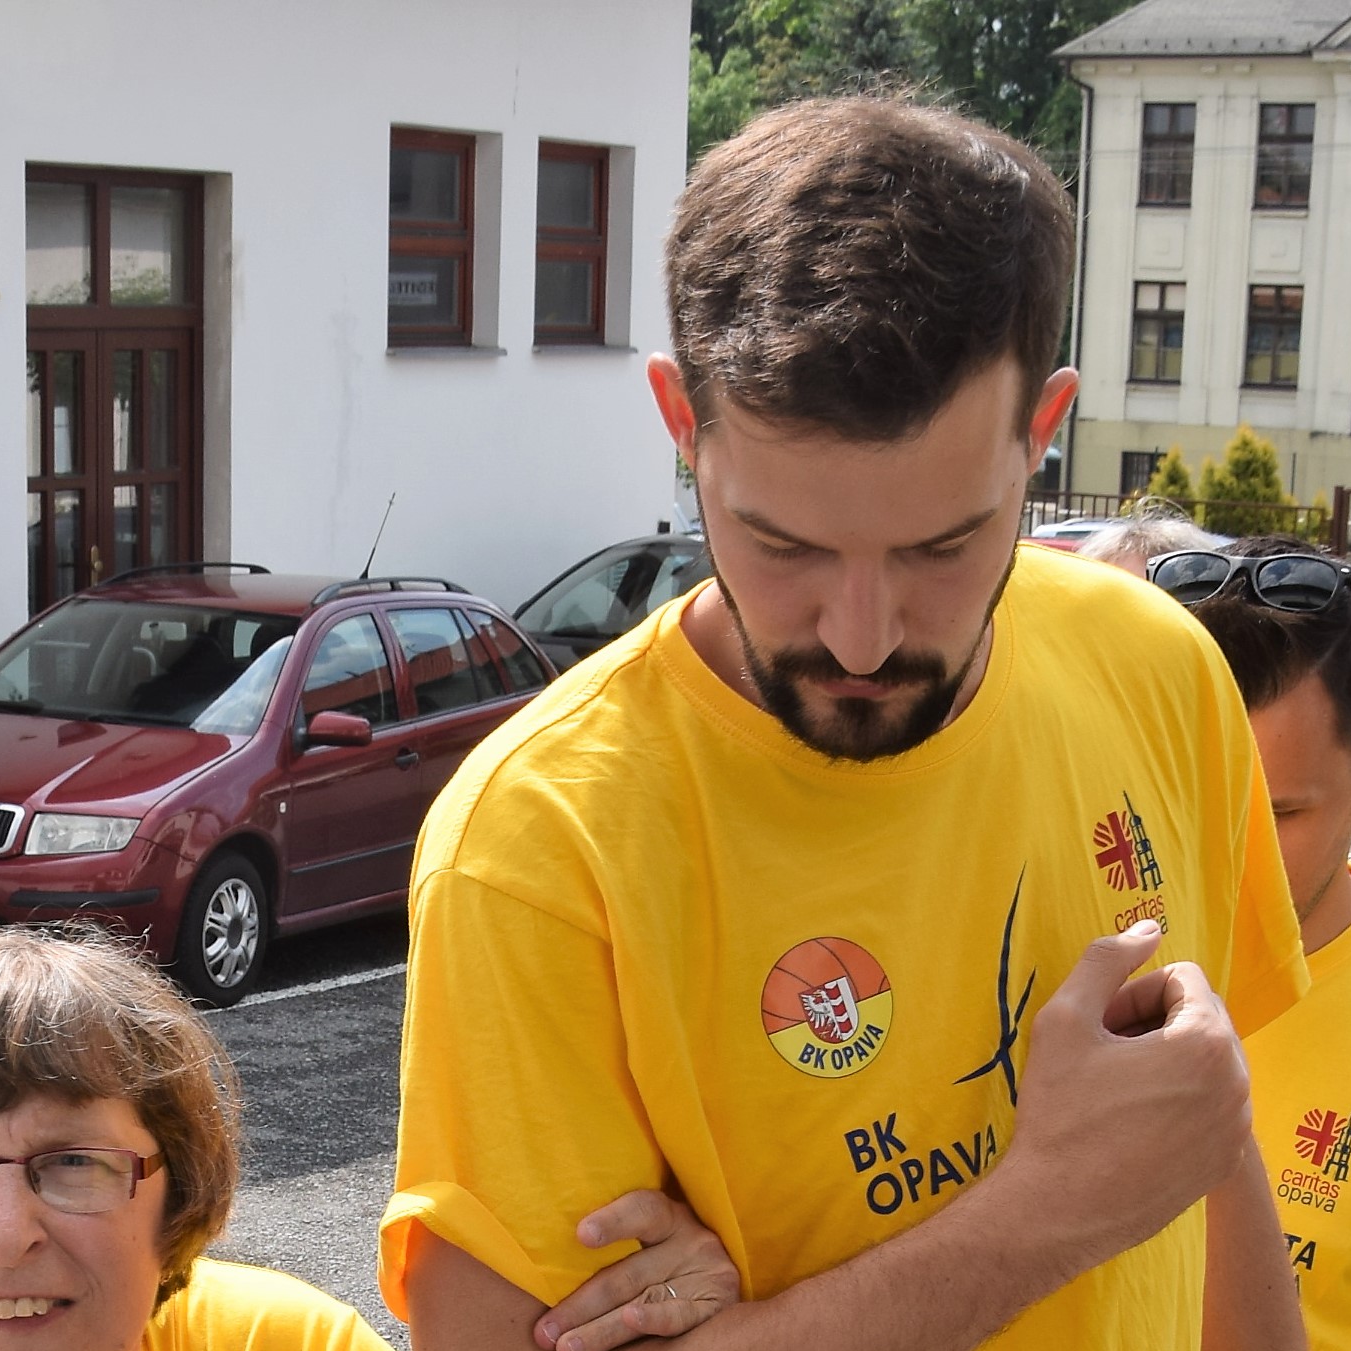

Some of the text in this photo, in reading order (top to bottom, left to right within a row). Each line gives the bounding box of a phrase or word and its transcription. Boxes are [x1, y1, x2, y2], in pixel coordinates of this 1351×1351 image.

[1114, 894, 1165, 934] caritas
[798, 1022, 885, 1071] BK OPAVA
[843, 1111, 907, 1173] BK
[866, 1123, 997, 1216] OPAVA
[1281, 1168, 1341, 1199] caritas
[1277, 1183, 1336, 1214] opava
